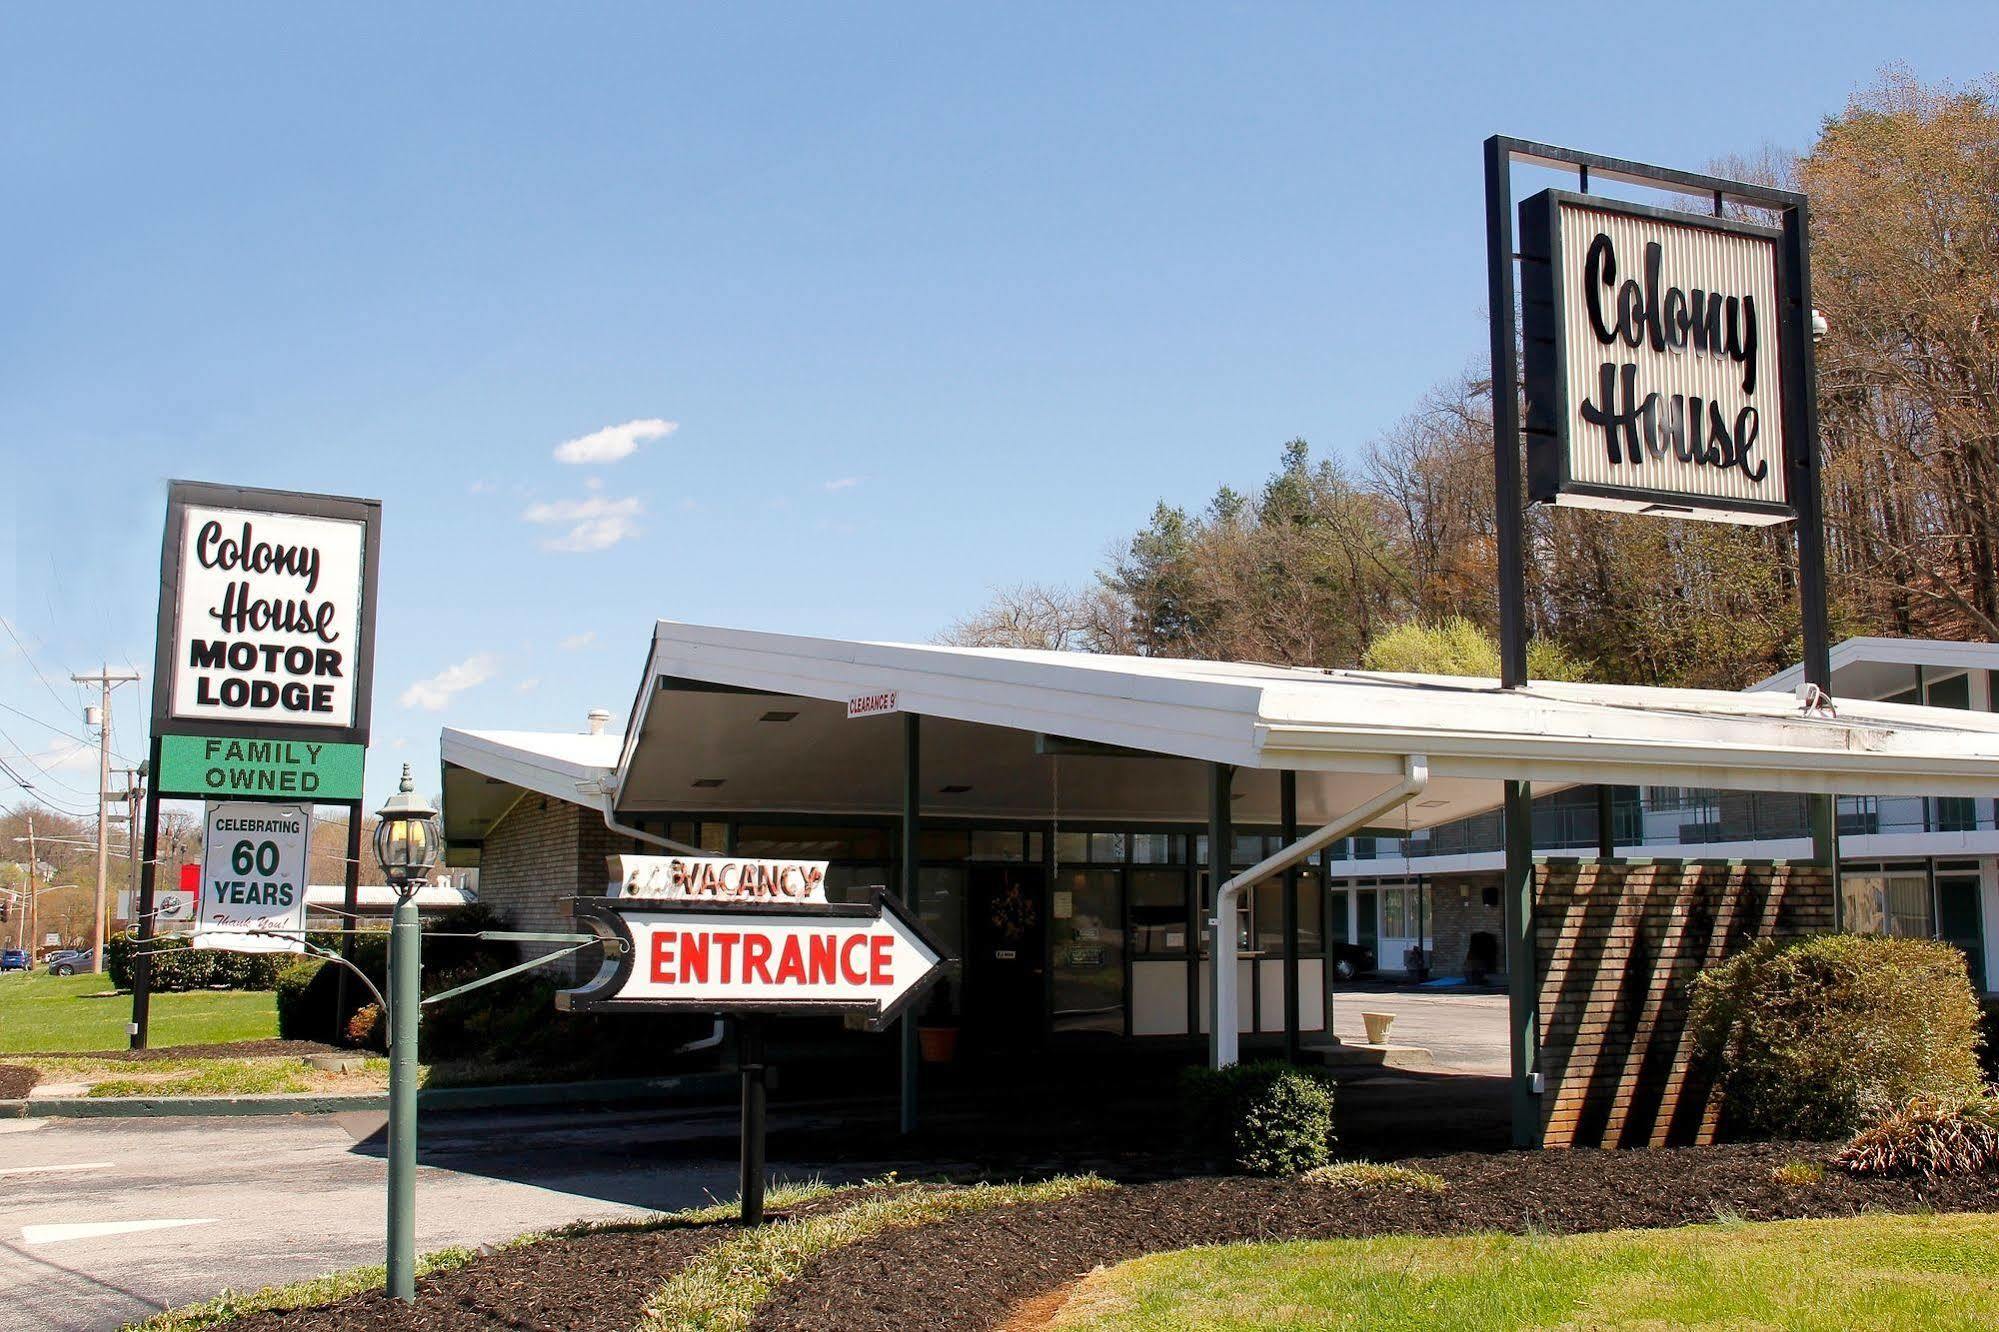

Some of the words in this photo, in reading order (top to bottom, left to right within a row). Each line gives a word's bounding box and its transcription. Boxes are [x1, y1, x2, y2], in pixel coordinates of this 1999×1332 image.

[1584, 233, 1757, 395] Colony
[1580, 363, 1768, 482] House
[197, 520, 320, 594] Colony
[209, 581, 340, 643] House
[190, 639, 343, 677] MOTOR
[197, 677, 335, 712] LODGE
[850, 694, 888, 714] CLEARANCE
[205, 740, 323, 765] FAMILY
[205, 767, 320, 792] OWNED
[216, 819, 300, 834] CELEBRATING
[231, 839, 280, 877] 60
[214, 881, 294, 906] YEARS
[678, 862, 823, 897] VACANCY
[213, 914, 252, 927] Thank
[257, 916, 290, 929] You!
[650, 931, 895, 985] ENTRANCE
